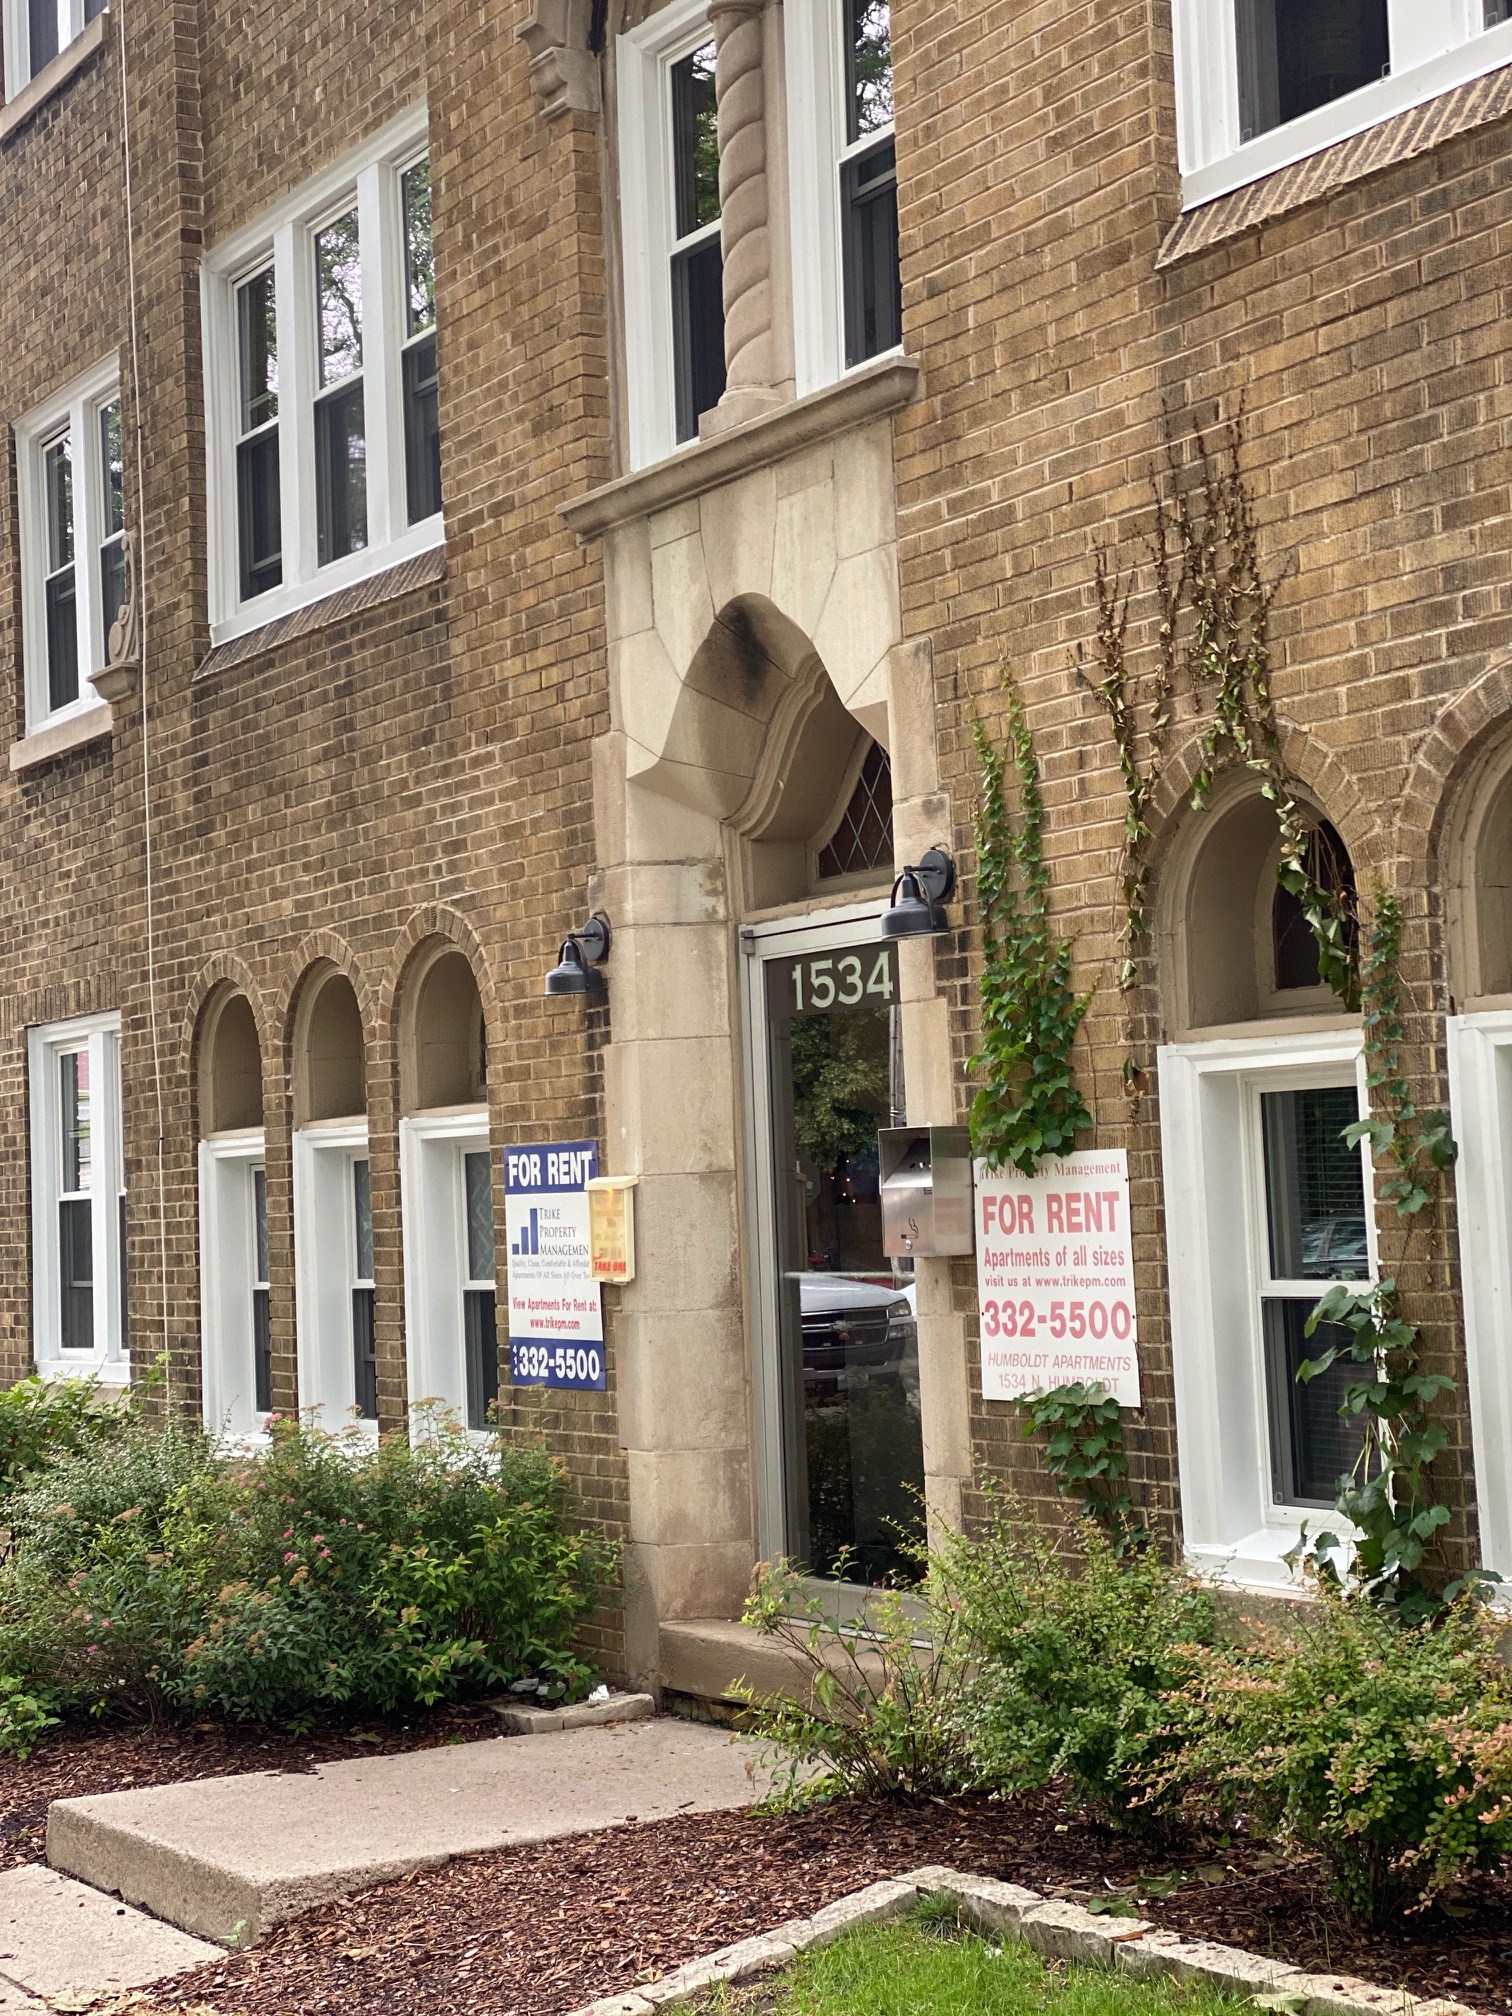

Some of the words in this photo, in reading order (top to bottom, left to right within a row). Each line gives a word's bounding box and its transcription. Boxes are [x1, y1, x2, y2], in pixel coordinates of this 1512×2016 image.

[792, 951, 893, 1010] 1534
[508, 1154, 541, 1186] FOR
[547, 1151, 592, 1185] RENT
[1055, 1162, 1120, 1177] Management
[539, 1208, 560, 1220] TRIKE
[983, 1194, 1035, 1235] FOR
[1046, 1191, 1120, 1233] RENT
[539, 1226, 576, 1238] PROPERTY
[540, 1244, 589, 1256] MANAGEMEN
[984, 1247, 1050, 1271] Apartments
[1056, 1245, 1067, 1266] of
[1073, 1245, 1087, 1266] all
[1093, 1245, 1125, 1266] sizes
[594, 1261, 611, 1272] TAKE
[985, 1275, 1004, 1287] visit
[1007, 1277, 1018, 1287] us
[1022, 1276, 1031, 1287] at
[1035, 1275, 1126, 1289] www.trikepm.com
[513, 1297, 526, 1310] View
[528, 1298, 560, 1312] Apartments
[562, 1298, 572, 1311] For
[573, 1299, 587, 1312] Rent
[589, 1300, 597, 1312] at:
[530, 1317, 580, 1331] www.trikepm.com
[984, 1300, 1132, 1340] 332-5500
[519, 1346, 600, 1381] 332-5500
[988, 1353, 1049, 1368] HUMBOLDT
[1053, 1354, 1131, 1371] APARTMENTS
[998, 1373, 1026, 1389] 1534
